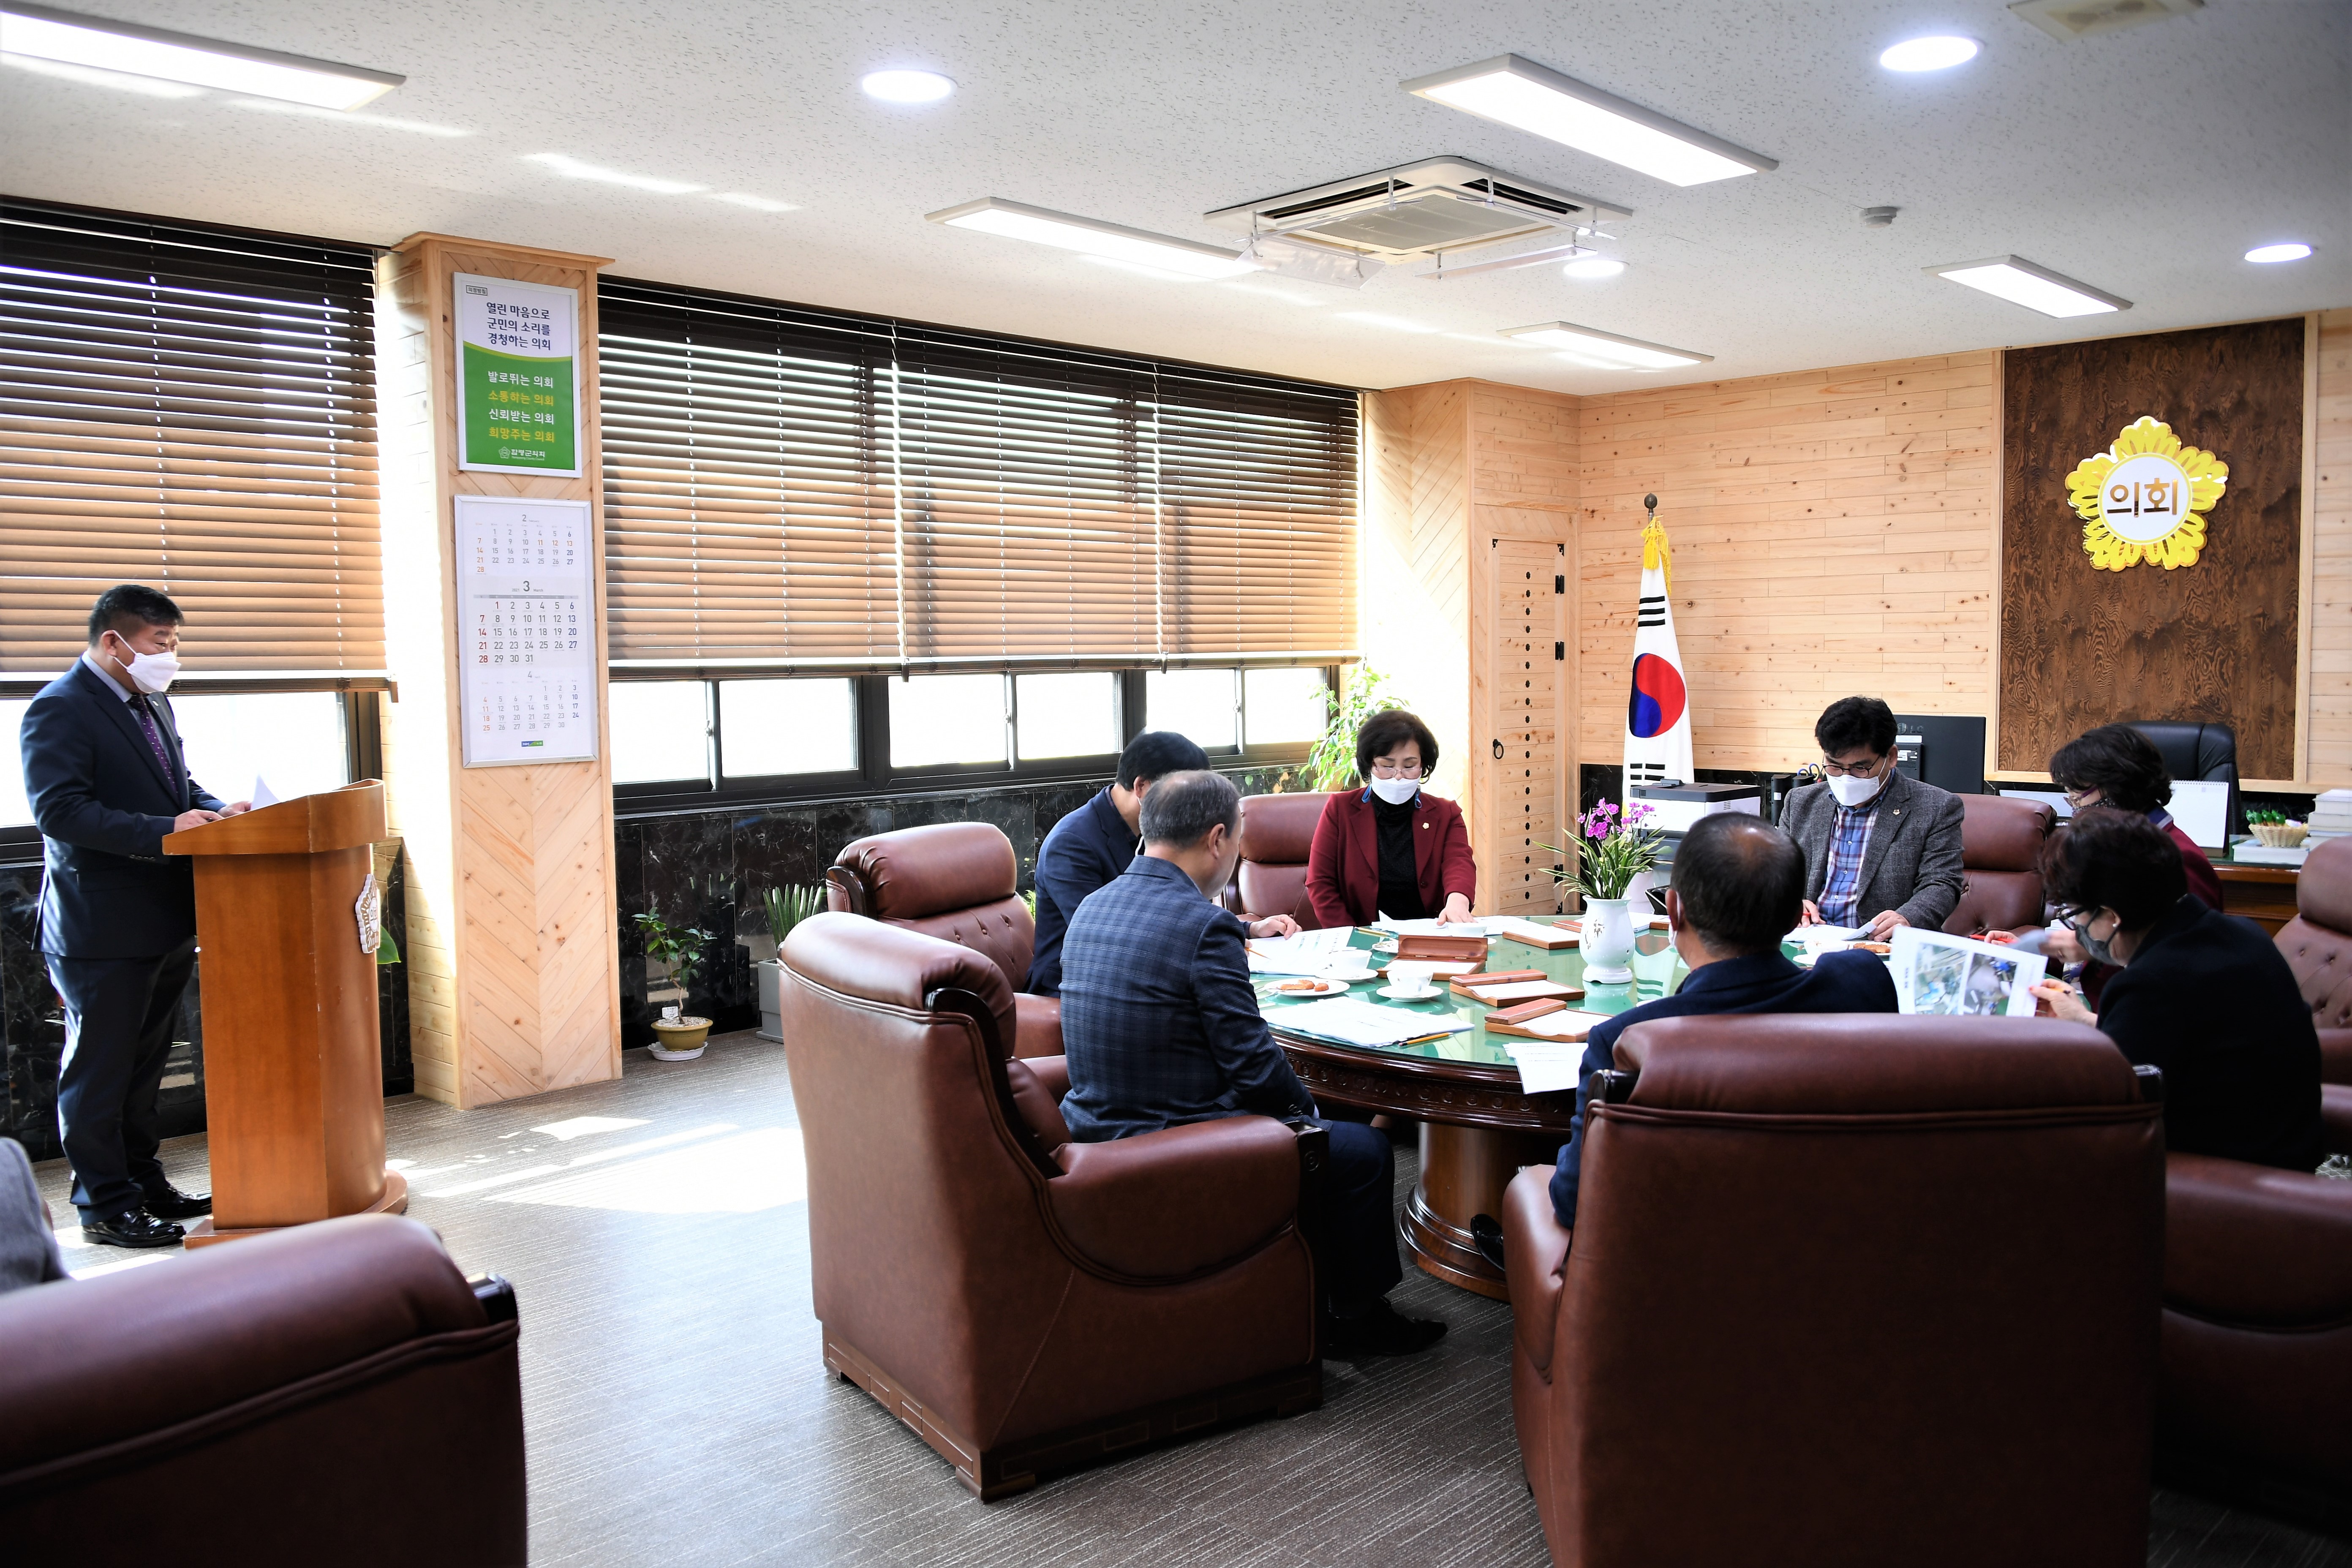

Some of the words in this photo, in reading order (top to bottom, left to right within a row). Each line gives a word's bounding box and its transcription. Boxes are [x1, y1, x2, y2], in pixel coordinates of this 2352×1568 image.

[487, 302, 506, 315] 열린
[510, 305, 550, 319] 마음으로
[487, 318, 517, 332] 군민의
[521, 322, 550, 336] 소리를
[488, 332, 528, 348] 경청하는
[532, 338, 550, 350] 의회
[488, 371, 530, 386] 발로뛰는
[534, 376, 553, 388] 의회
[488, 390, 530, 404] 소통하는
[534, 395, 553, 406] 의회
[489, 408, 531, 422] 신뢰받는
[534, 413, 554, 425] 의회
[489, 427, 531, 441] 희망주는
[535, 431, 554, 443] 의회
[511, 449, 545, 457] 함평군의회
[2107, 478, 2178, 517] 의회
[522, 514, 527, 522] 2
[523, 580, 530, 592] 3
[510, 602, 515, 610] 2
[525, 602, 530, 610] 3
[539, 602, 544, 610] 4
[479, 615, 485, 623] 7
[495, 615, 500, 623] 8
[510, 615, 515, 623] 9
[523, 615, 532, 623] 10
[568, 615, 576, 623] 13
[478, 628, 487, 636] 14
[493, 628, 502, 636] 15
[509, 628, 517, 636] 16
[553, 628, 562, 636] 19
[479, 642, 487, 650] 21
[509, 641, 519, 649] 23
[554, 641, 563, 649] 26
[479, 655, 488, 663] 28
[494, 655, 504, 663] 29
[525, 654, 533, 662] 31
